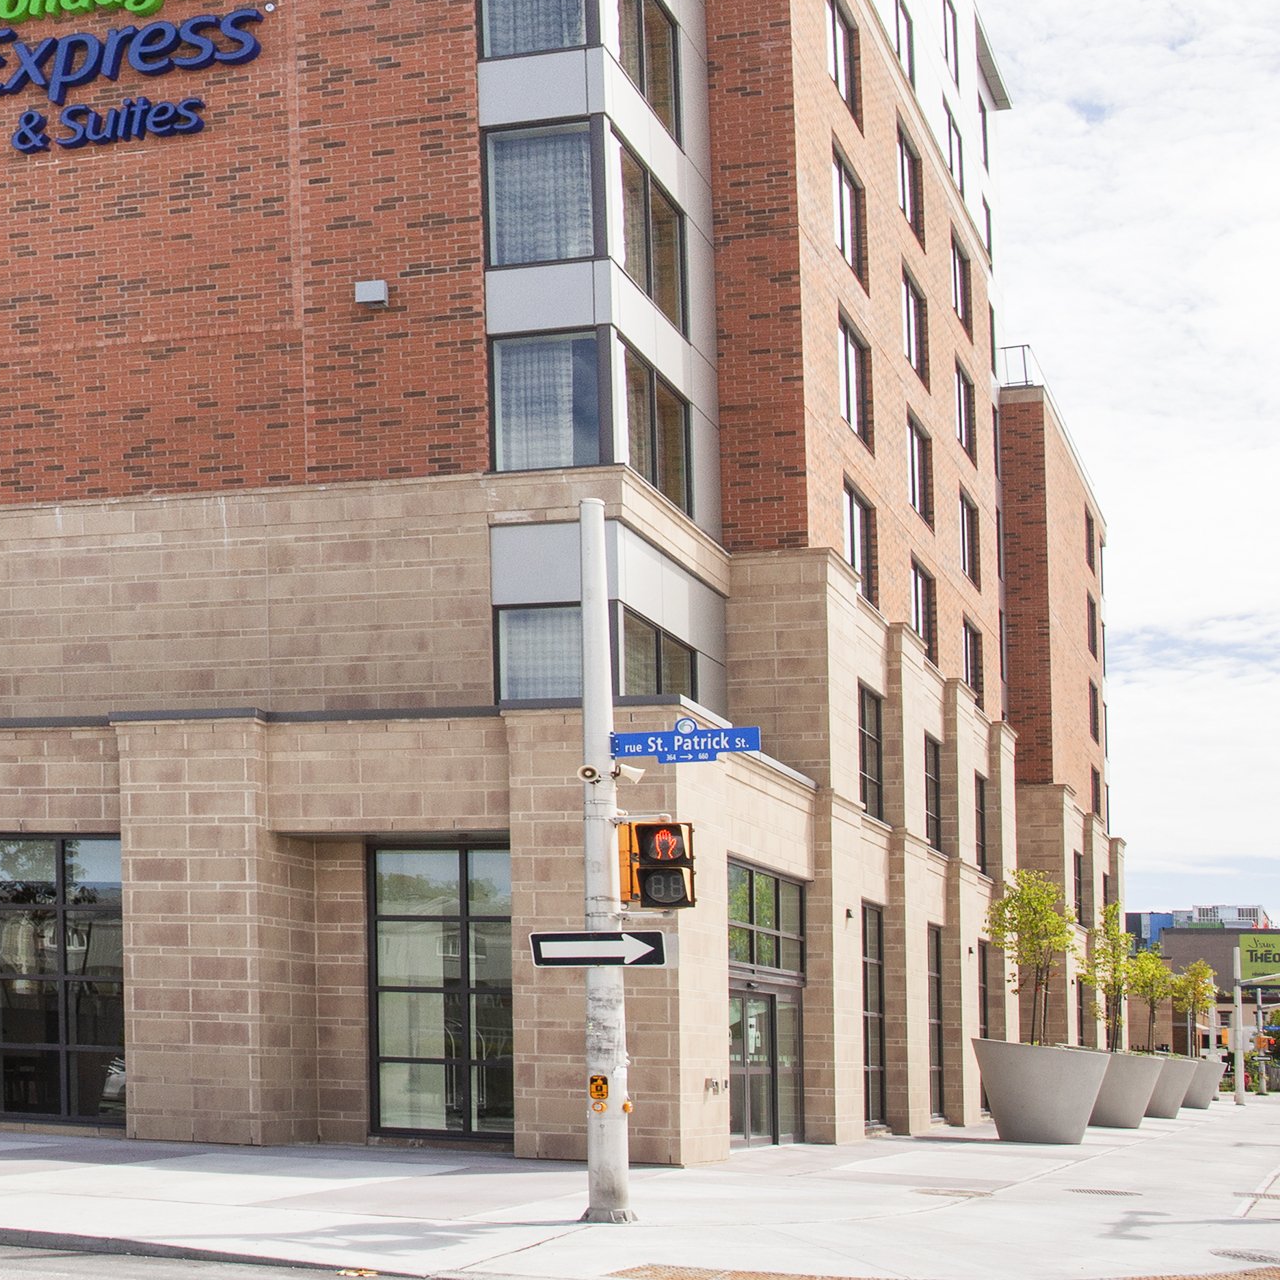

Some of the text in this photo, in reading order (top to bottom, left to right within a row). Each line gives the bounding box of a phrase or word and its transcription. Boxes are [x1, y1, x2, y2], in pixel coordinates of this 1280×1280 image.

[11, 97, 206, 154] & Suites
[624, 732, 750, 753] rue St. Patrick St.
